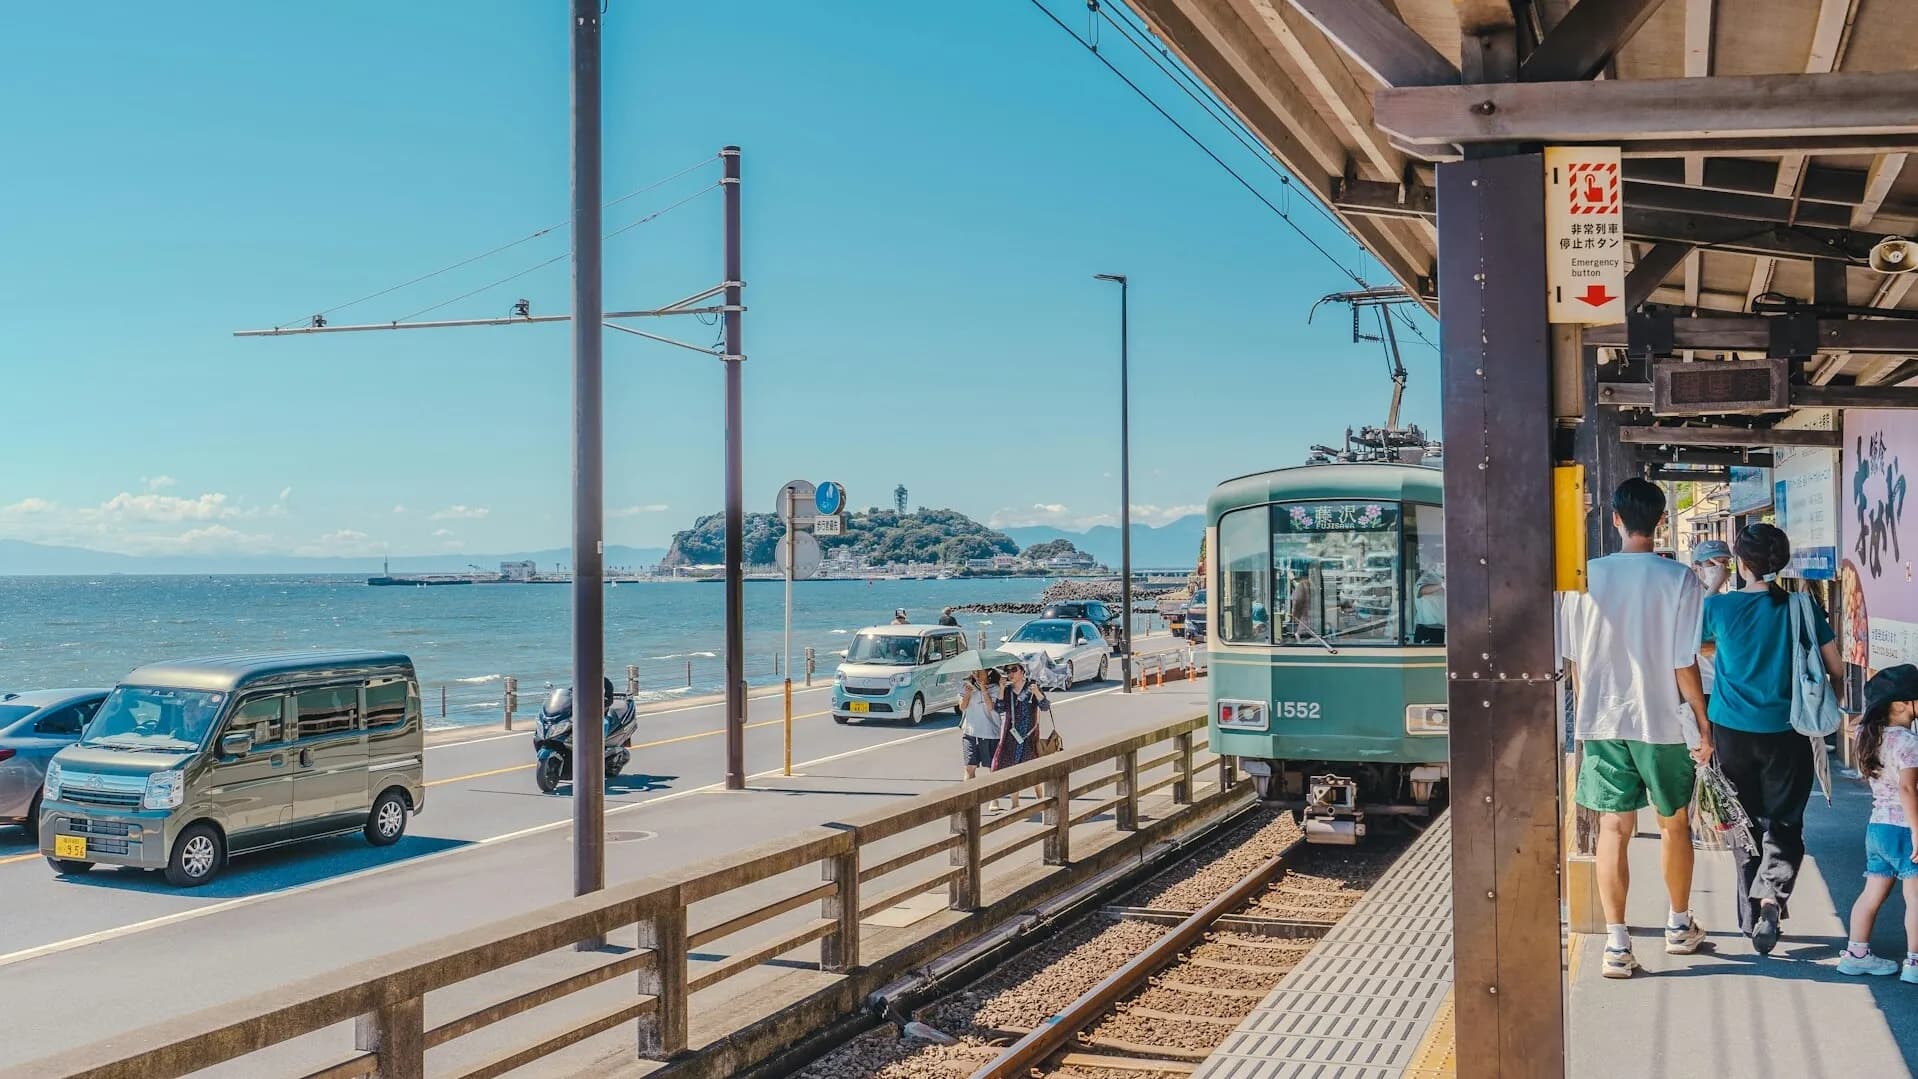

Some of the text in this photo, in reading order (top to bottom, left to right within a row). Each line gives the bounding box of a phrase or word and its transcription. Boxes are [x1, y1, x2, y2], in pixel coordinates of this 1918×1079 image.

[1571, 223, 1619, 235] 非常列車
[1560, 238, 1619, 250] 停止ボタン
[1571, 258, 1619, 268] Emergency
[1571, 269, 1601, 277] button
[1314, 505, 1357, 524] 藤沢
[1316, 522, 1355, 530] FUJISAWA
[1276, 701, 1320, 719] 1552
